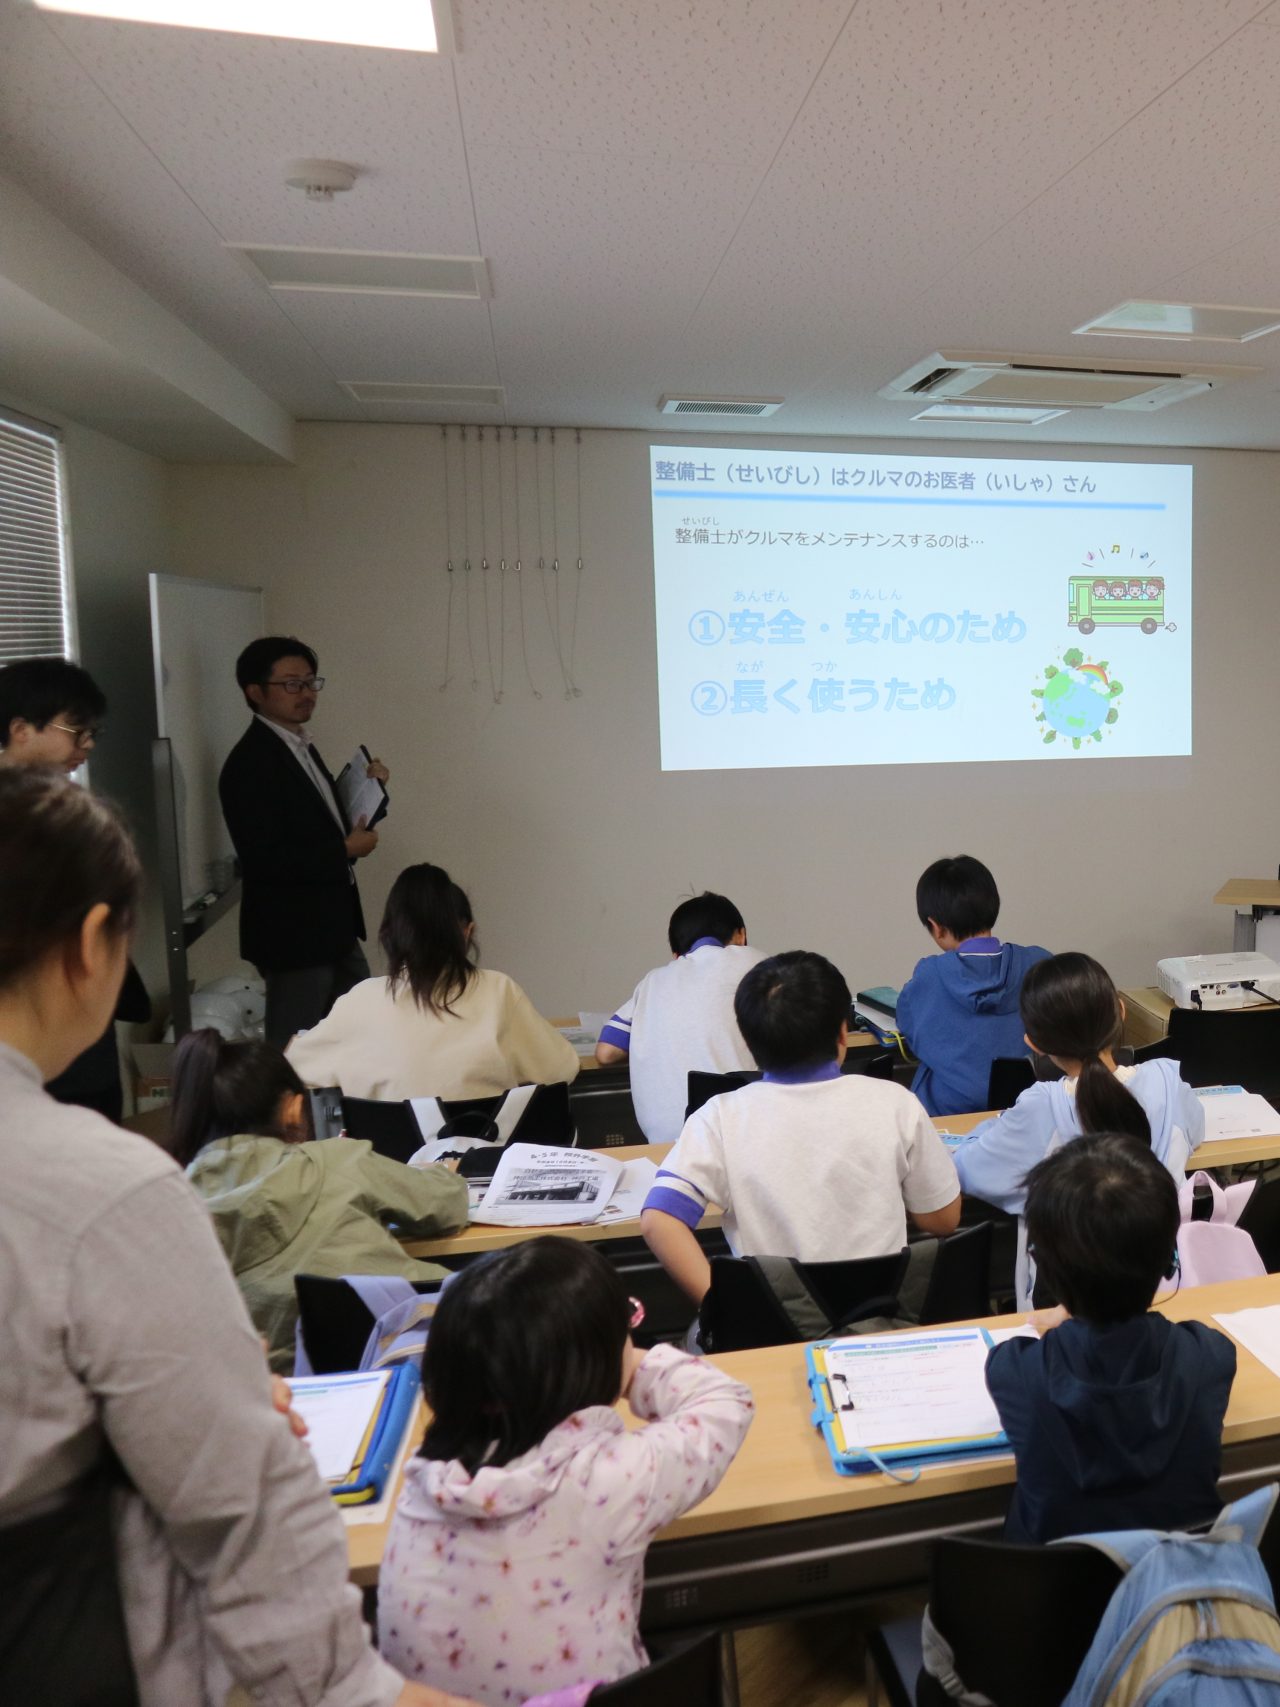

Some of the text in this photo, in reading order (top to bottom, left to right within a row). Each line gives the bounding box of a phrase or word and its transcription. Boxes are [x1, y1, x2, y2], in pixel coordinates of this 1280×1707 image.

[655, 461, 1097, 494] 整備士（せいびし）はクルマのお医者（いしゃ）さん
[682, 516, 720, 526] せいびし
[733, 590, 790, 602] あんぜん
[849, 588, 903, 601] あんしん
[736, 660, 764, 673] なが
[811, 661, 837, 673] つか
